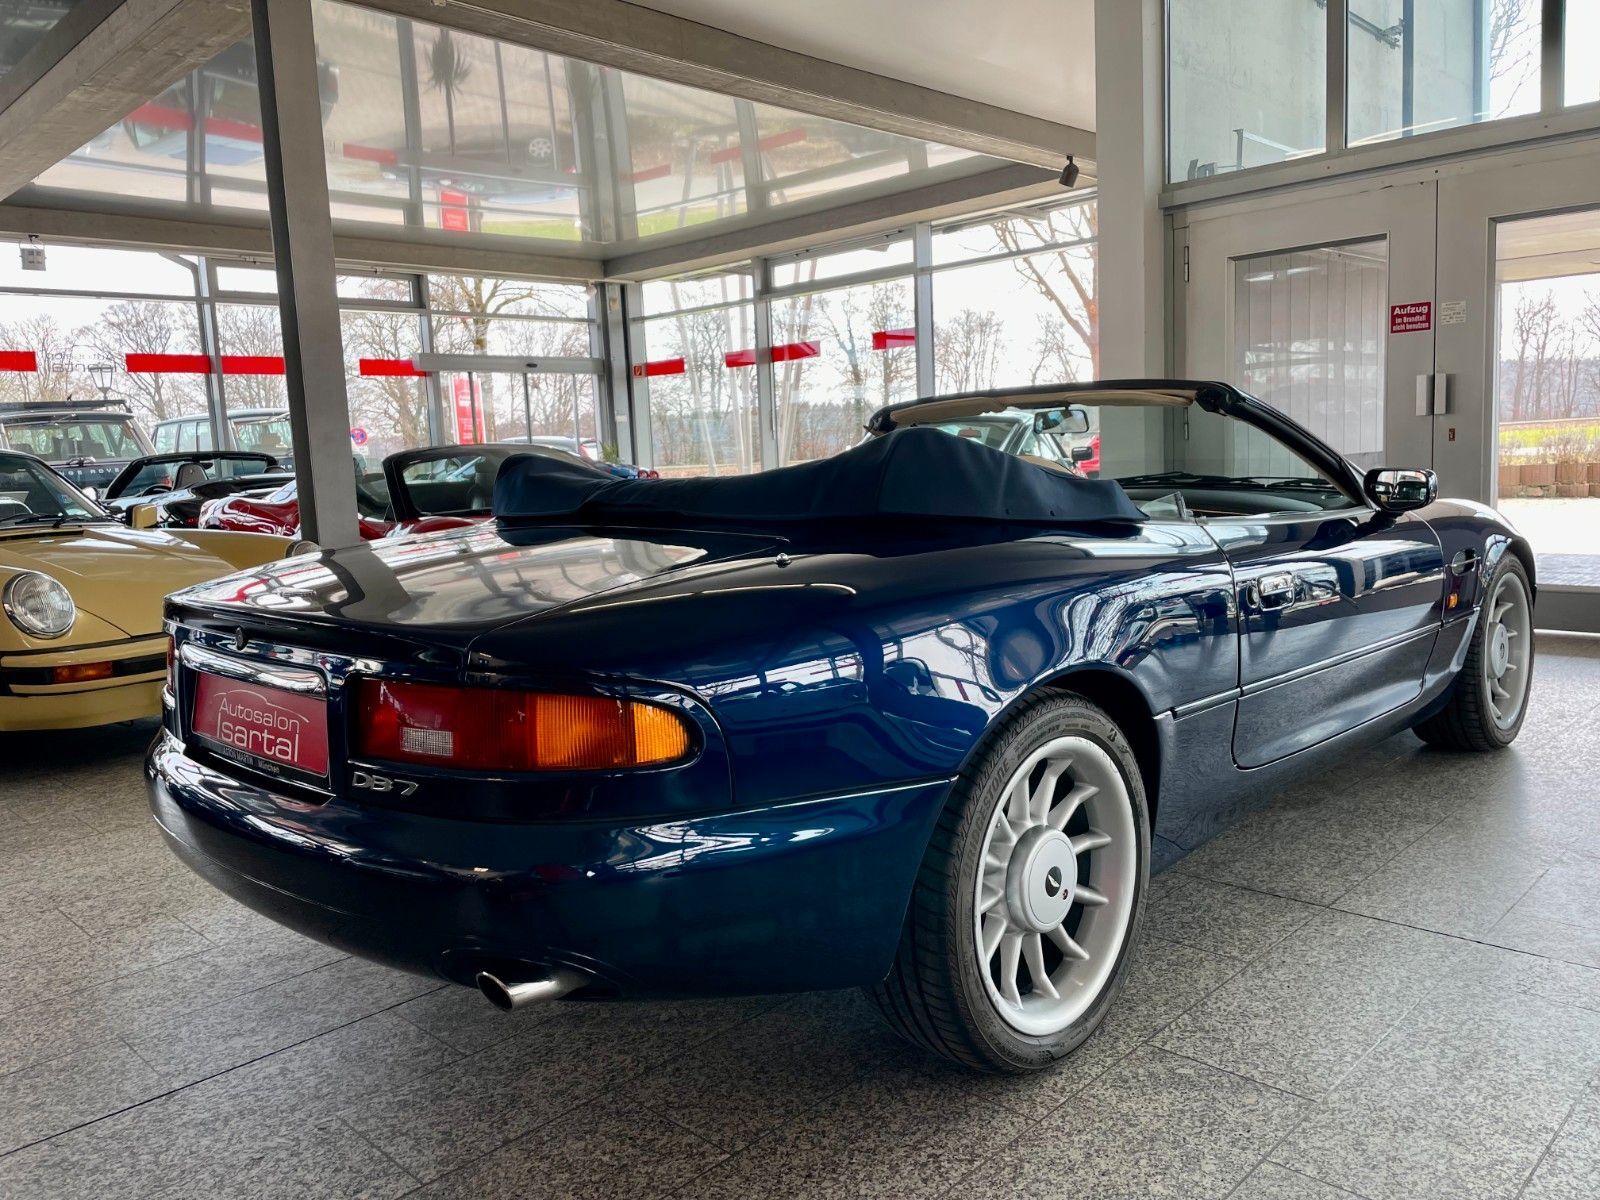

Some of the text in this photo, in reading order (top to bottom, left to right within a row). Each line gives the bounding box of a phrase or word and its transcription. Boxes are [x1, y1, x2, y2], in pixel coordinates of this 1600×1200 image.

[1393, 305, 1428, 315] Aufzug
[1403, 315, 1426, 323] Brandfall
[1406, 322, 1429, 330] benutzen
[219, 697, 300, 733] Autosalon
[216, 712, 299, 763] Isartal
